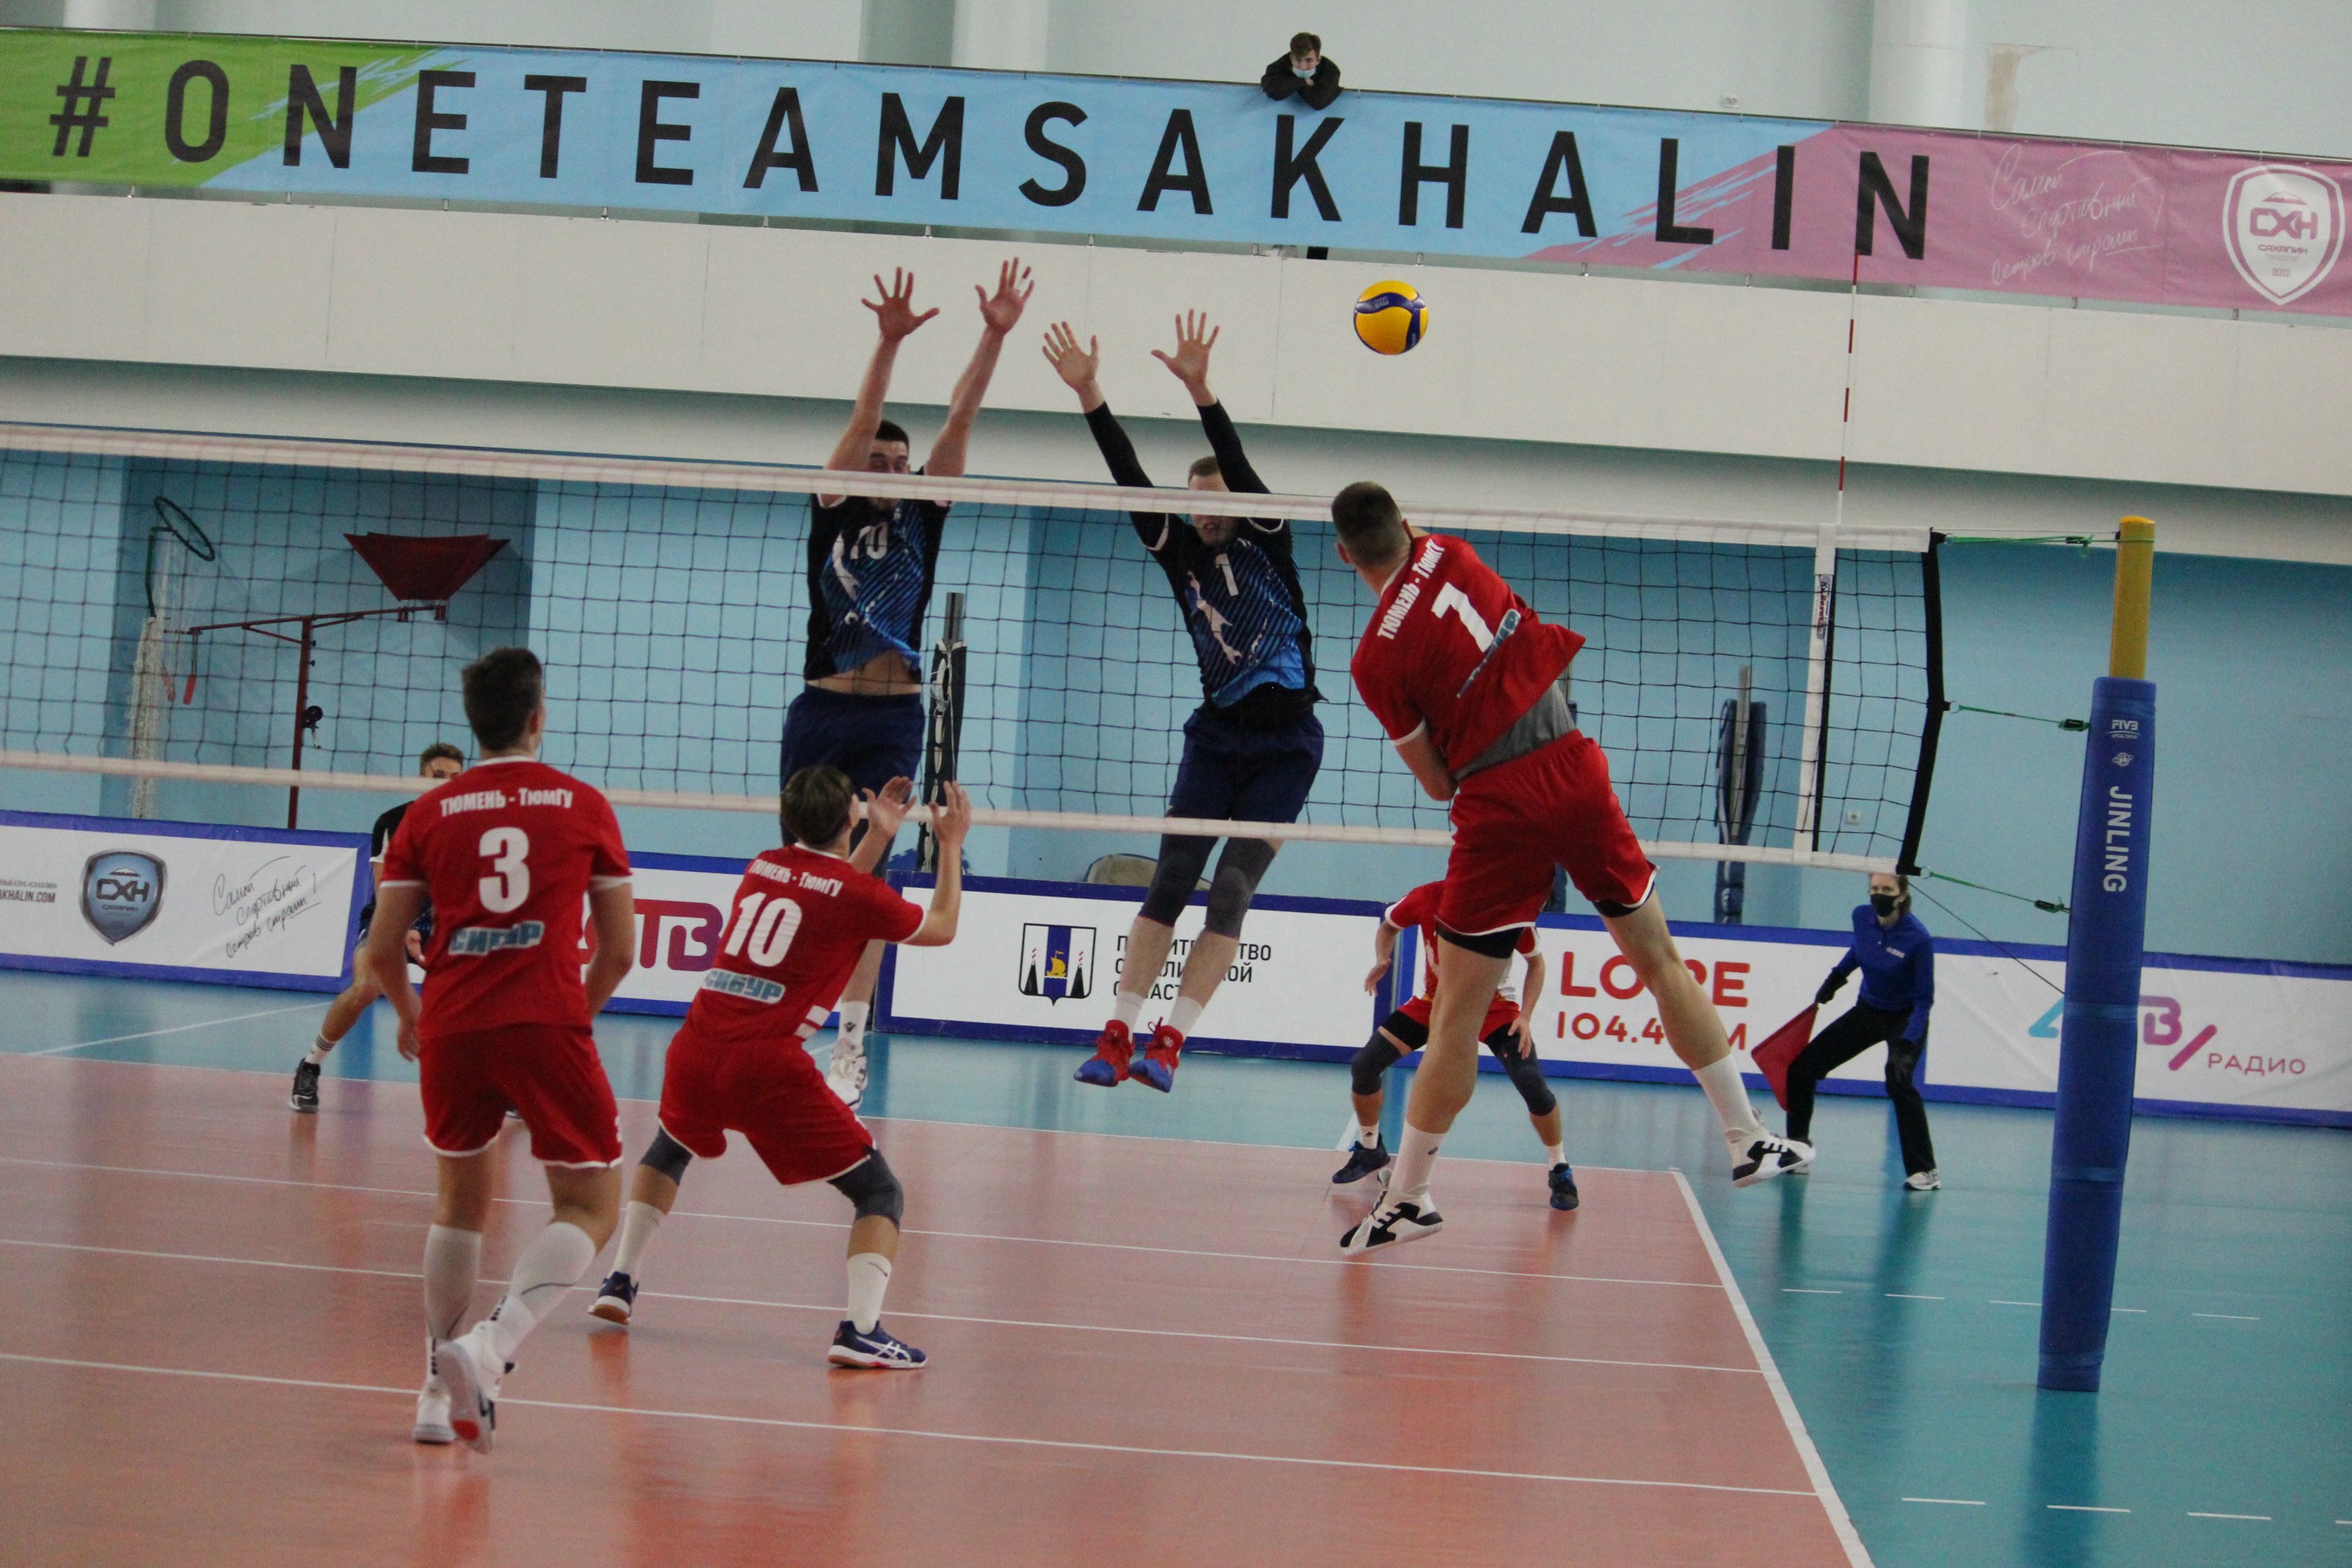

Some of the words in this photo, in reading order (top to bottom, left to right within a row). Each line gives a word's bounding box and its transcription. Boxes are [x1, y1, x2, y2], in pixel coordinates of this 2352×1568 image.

[1215, 552, 1240, 597] 1
[1431, 581, 1495, 653] 7
[2112, 719, 2139, 731] FIVB
[439, 789, 506, 818] ТЮМЕНЬ
[2103, 786, 2133, 893] JINLING
[479, 827, 531, 914] 3
[725, 891, 803, 968] 10
[1557, 1010, 1665, 1045] 104.4
[2208, 1052, 2307, 1077] РАДИО
